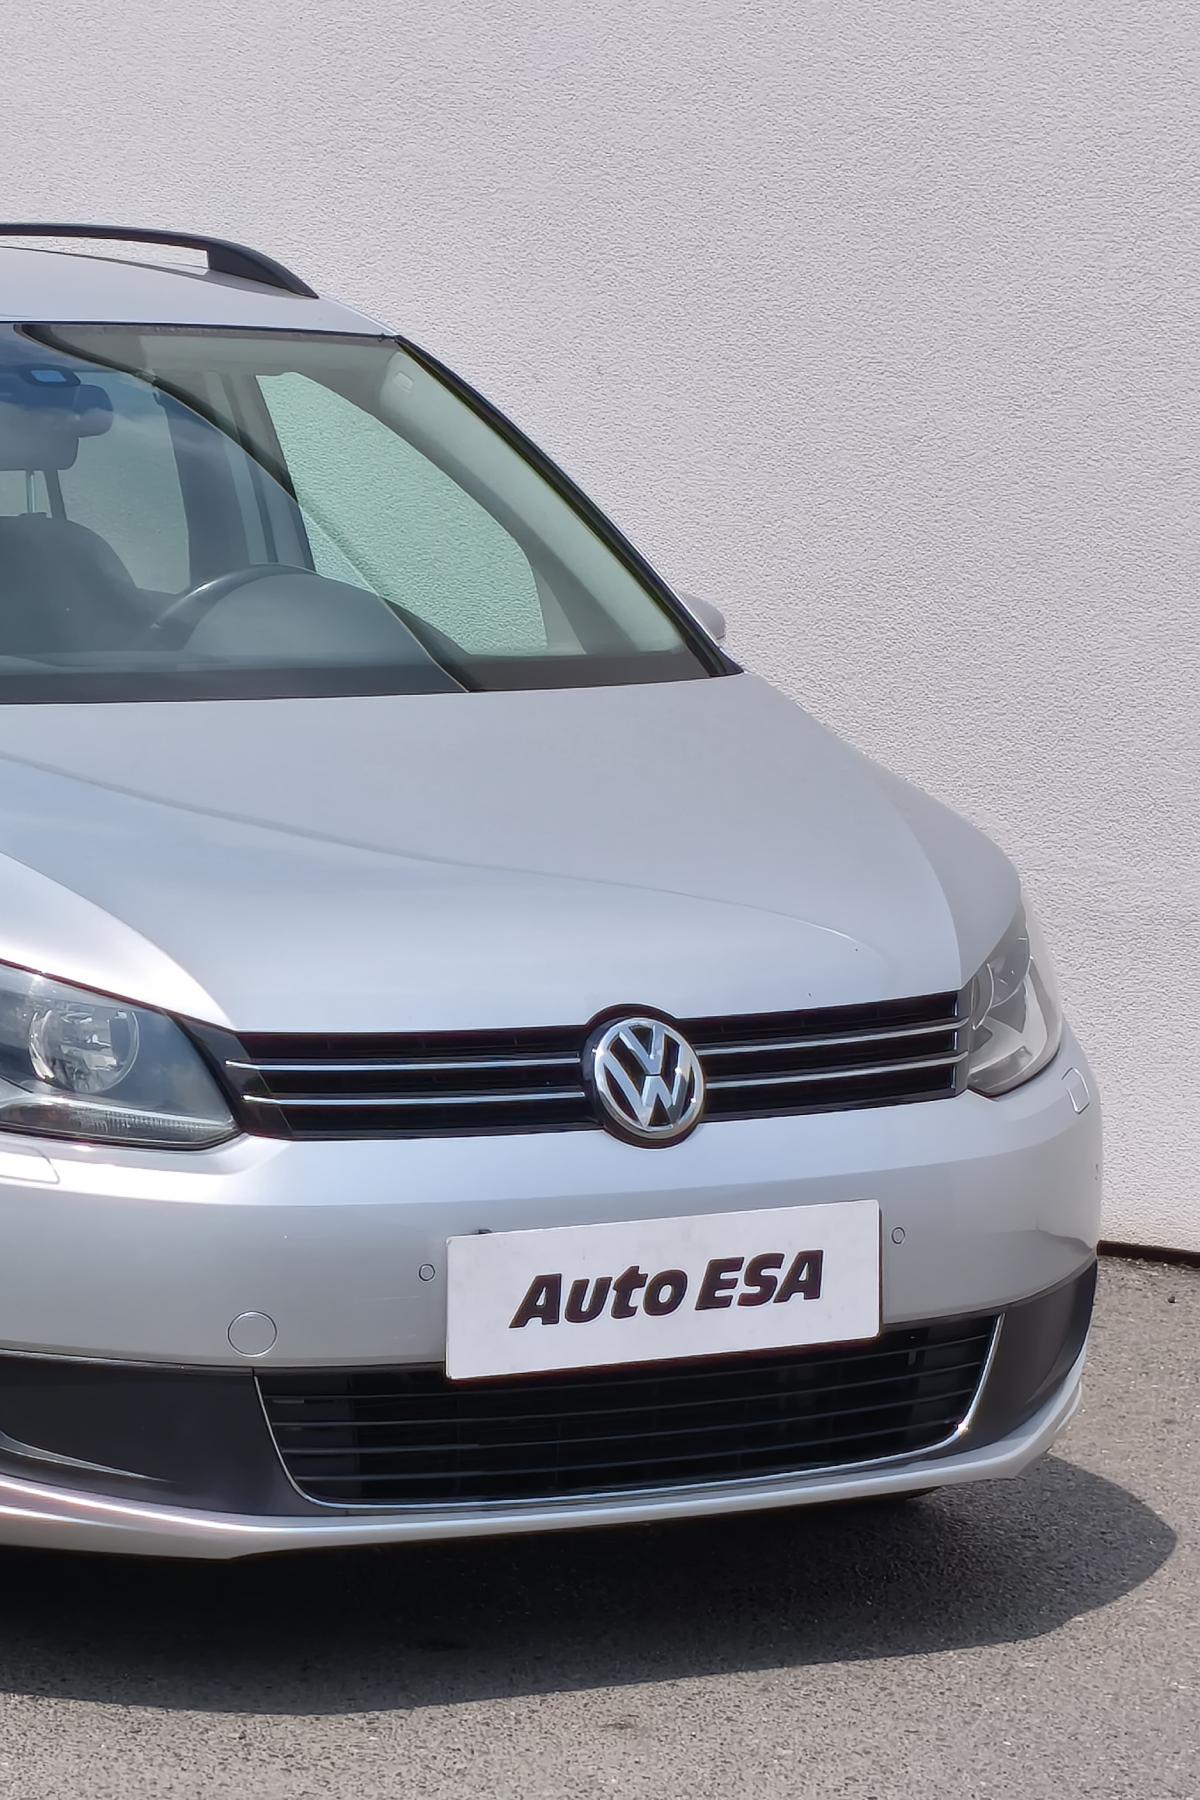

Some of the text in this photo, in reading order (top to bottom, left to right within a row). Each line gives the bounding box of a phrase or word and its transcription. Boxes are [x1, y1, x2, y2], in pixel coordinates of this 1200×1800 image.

[595, 1018, 703, 1138] VW
[508, 1249, 824, 1329] Auto ESA
